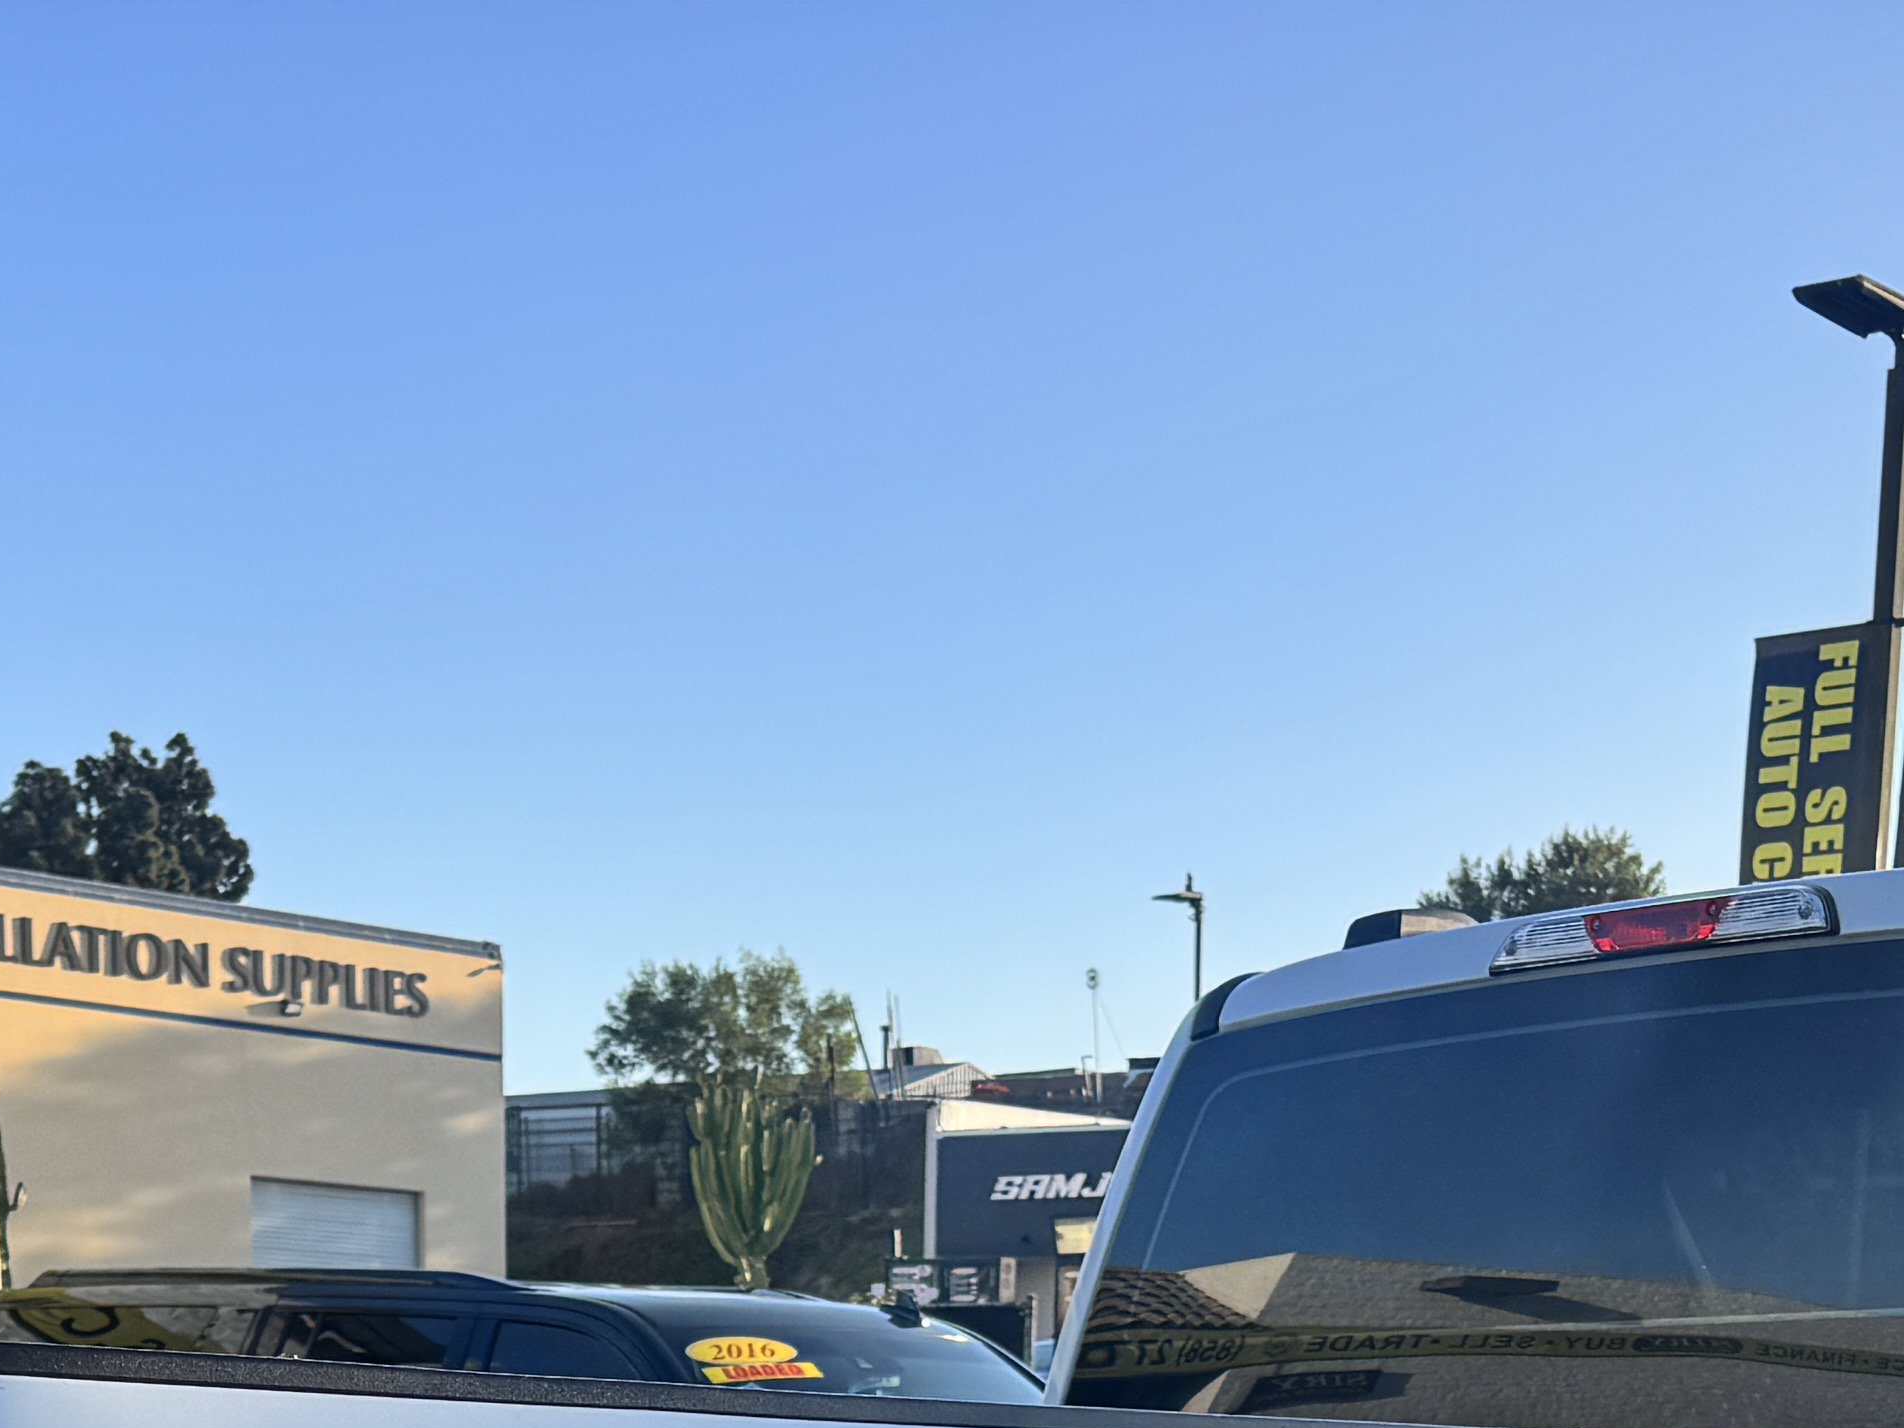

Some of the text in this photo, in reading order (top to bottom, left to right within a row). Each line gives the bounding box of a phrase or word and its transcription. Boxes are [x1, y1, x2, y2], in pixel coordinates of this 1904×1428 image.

[1810, 640, 1859, 763] FULL
[1756, 685, 1805, 828] AUTO
[221, 945, 431, 1018] SUPPLIES
[708, 1342, 776, 1361] 2016
[721, 1363, 805, 1380] LOADED
